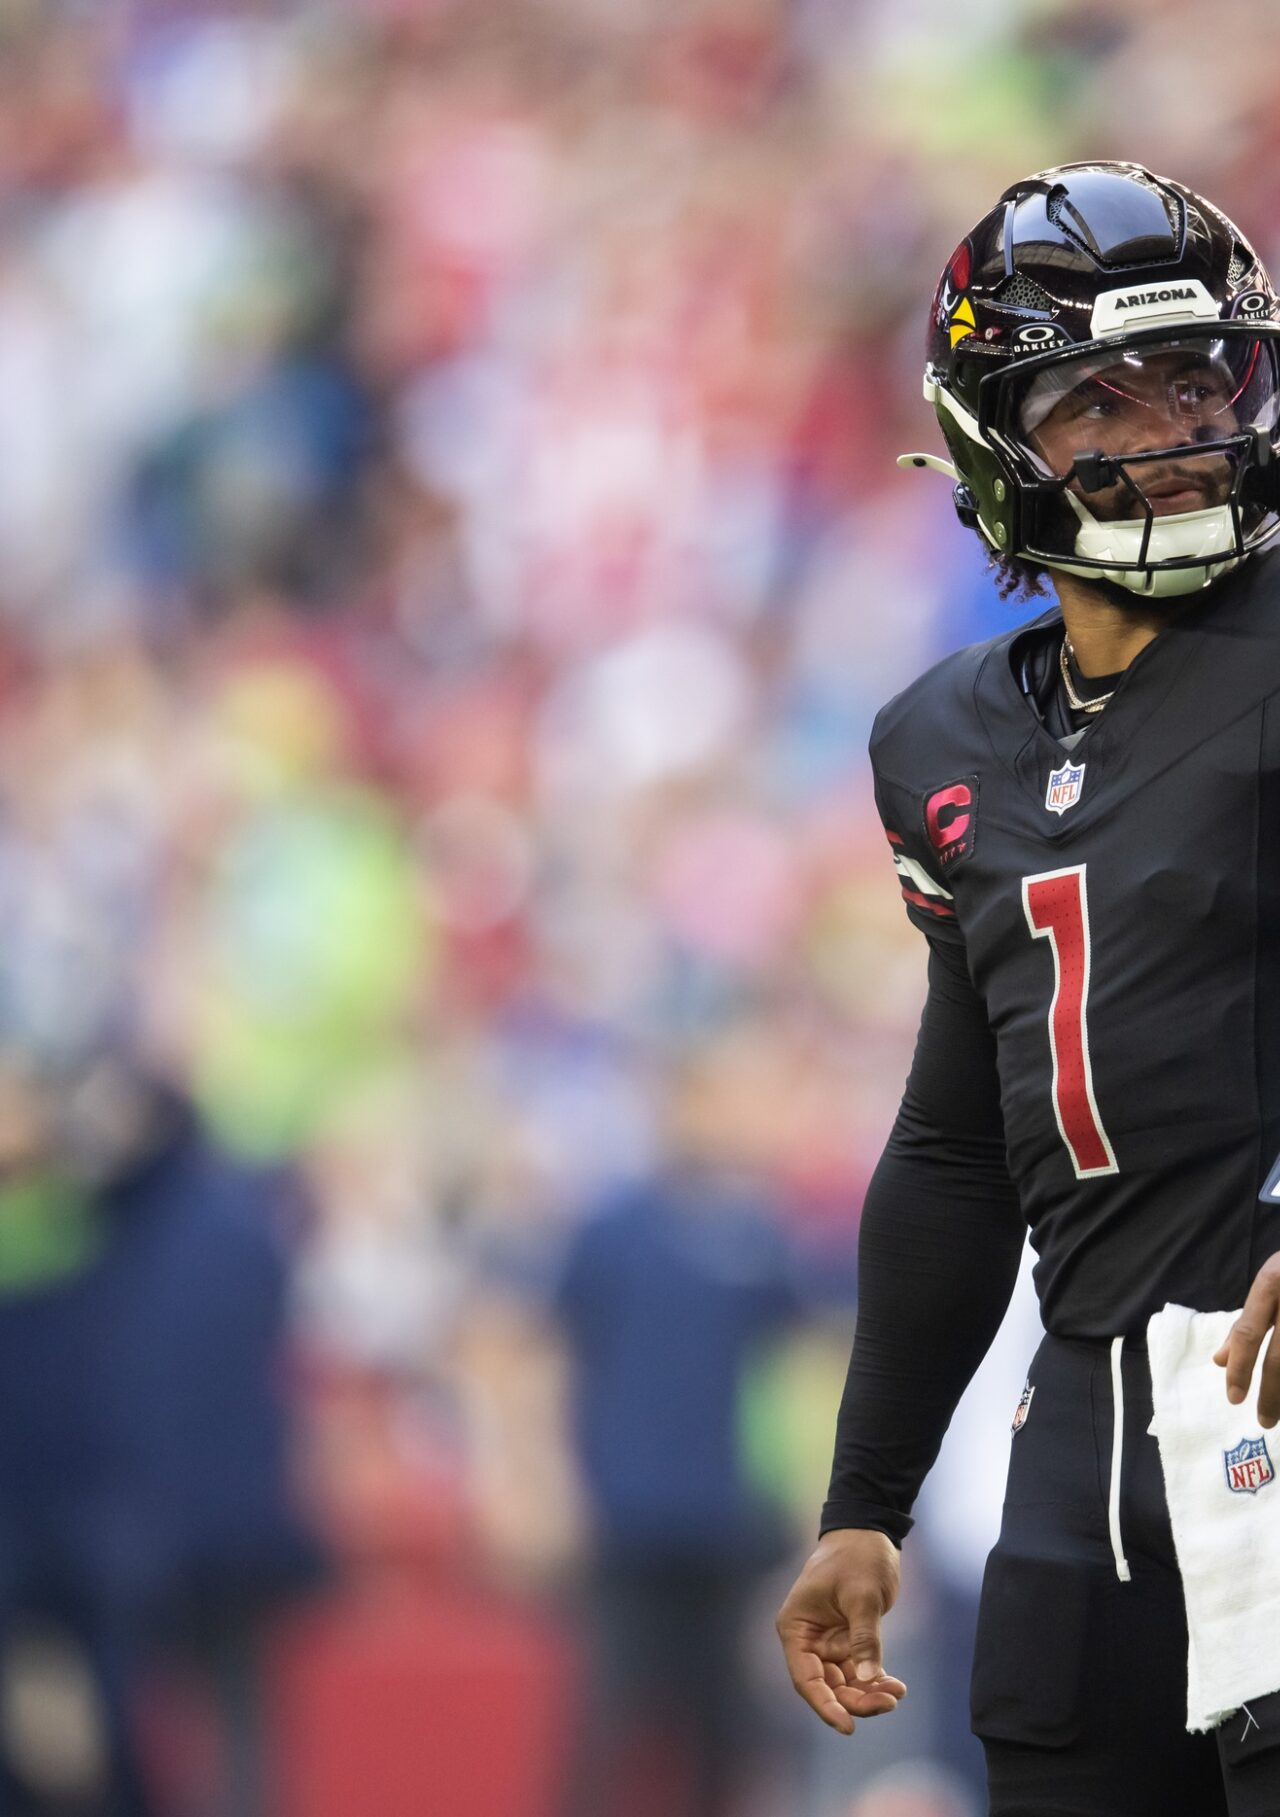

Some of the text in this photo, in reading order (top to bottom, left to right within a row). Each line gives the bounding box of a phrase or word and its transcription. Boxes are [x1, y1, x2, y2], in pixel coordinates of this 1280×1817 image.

[1114, 287, 1197, 310] ARIZONA
[1237, 309, 1270, 320] OAKLEY
[1013, 339, 1066, 353] OAKLEY
[1051, 784, 1075, 804] NFL
[926, 784, 971, 849] C
[1021, 863, 1120, 1180] 1
[1230, 1458, 1270, 1488] NFL
